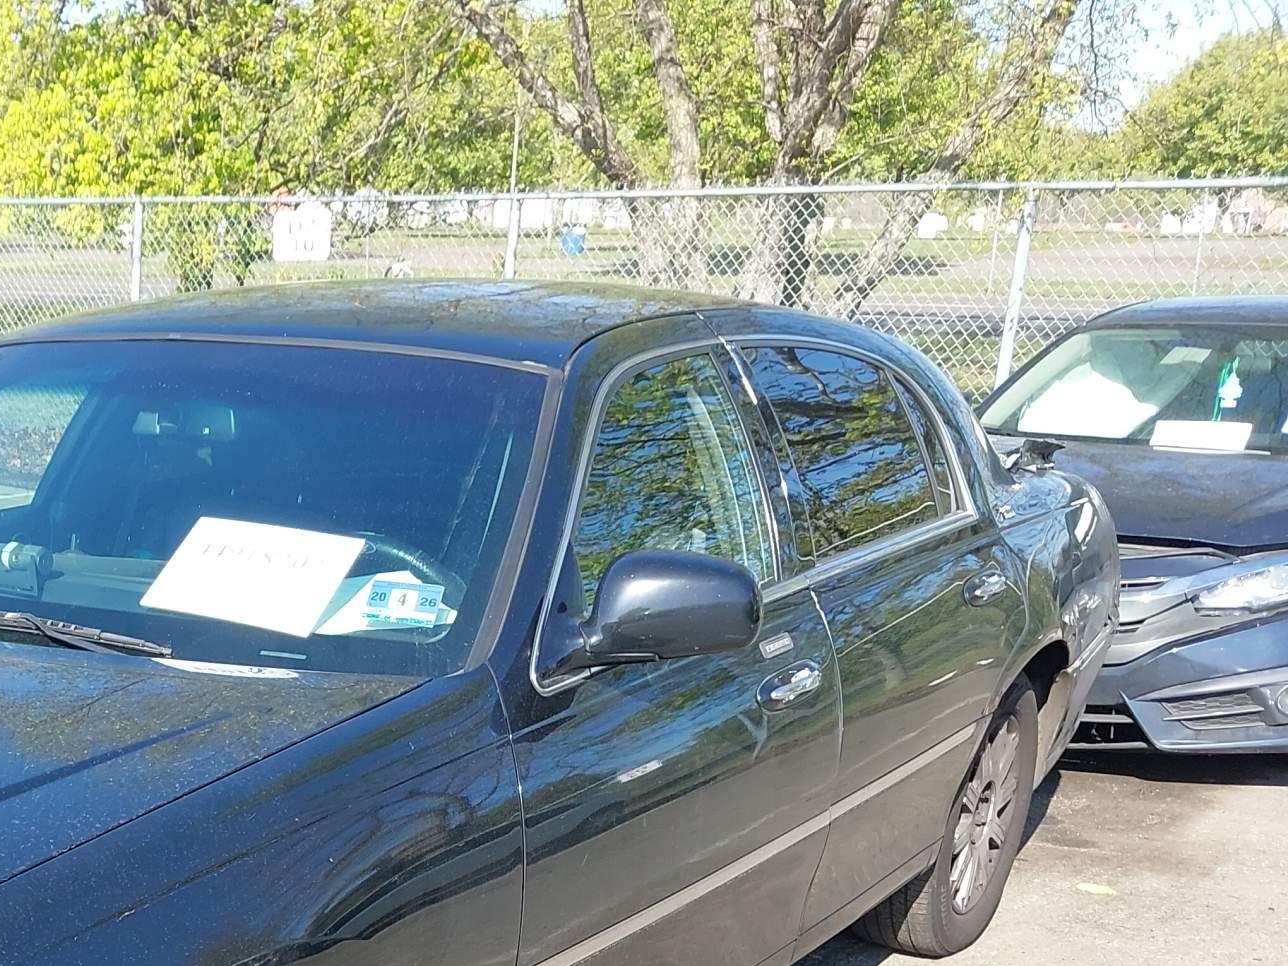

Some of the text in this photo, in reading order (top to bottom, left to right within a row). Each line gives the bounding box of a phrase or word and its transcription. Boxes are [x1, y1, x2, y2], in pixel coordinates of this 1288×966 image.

[370, 591, 438, 608] 20 4 26
